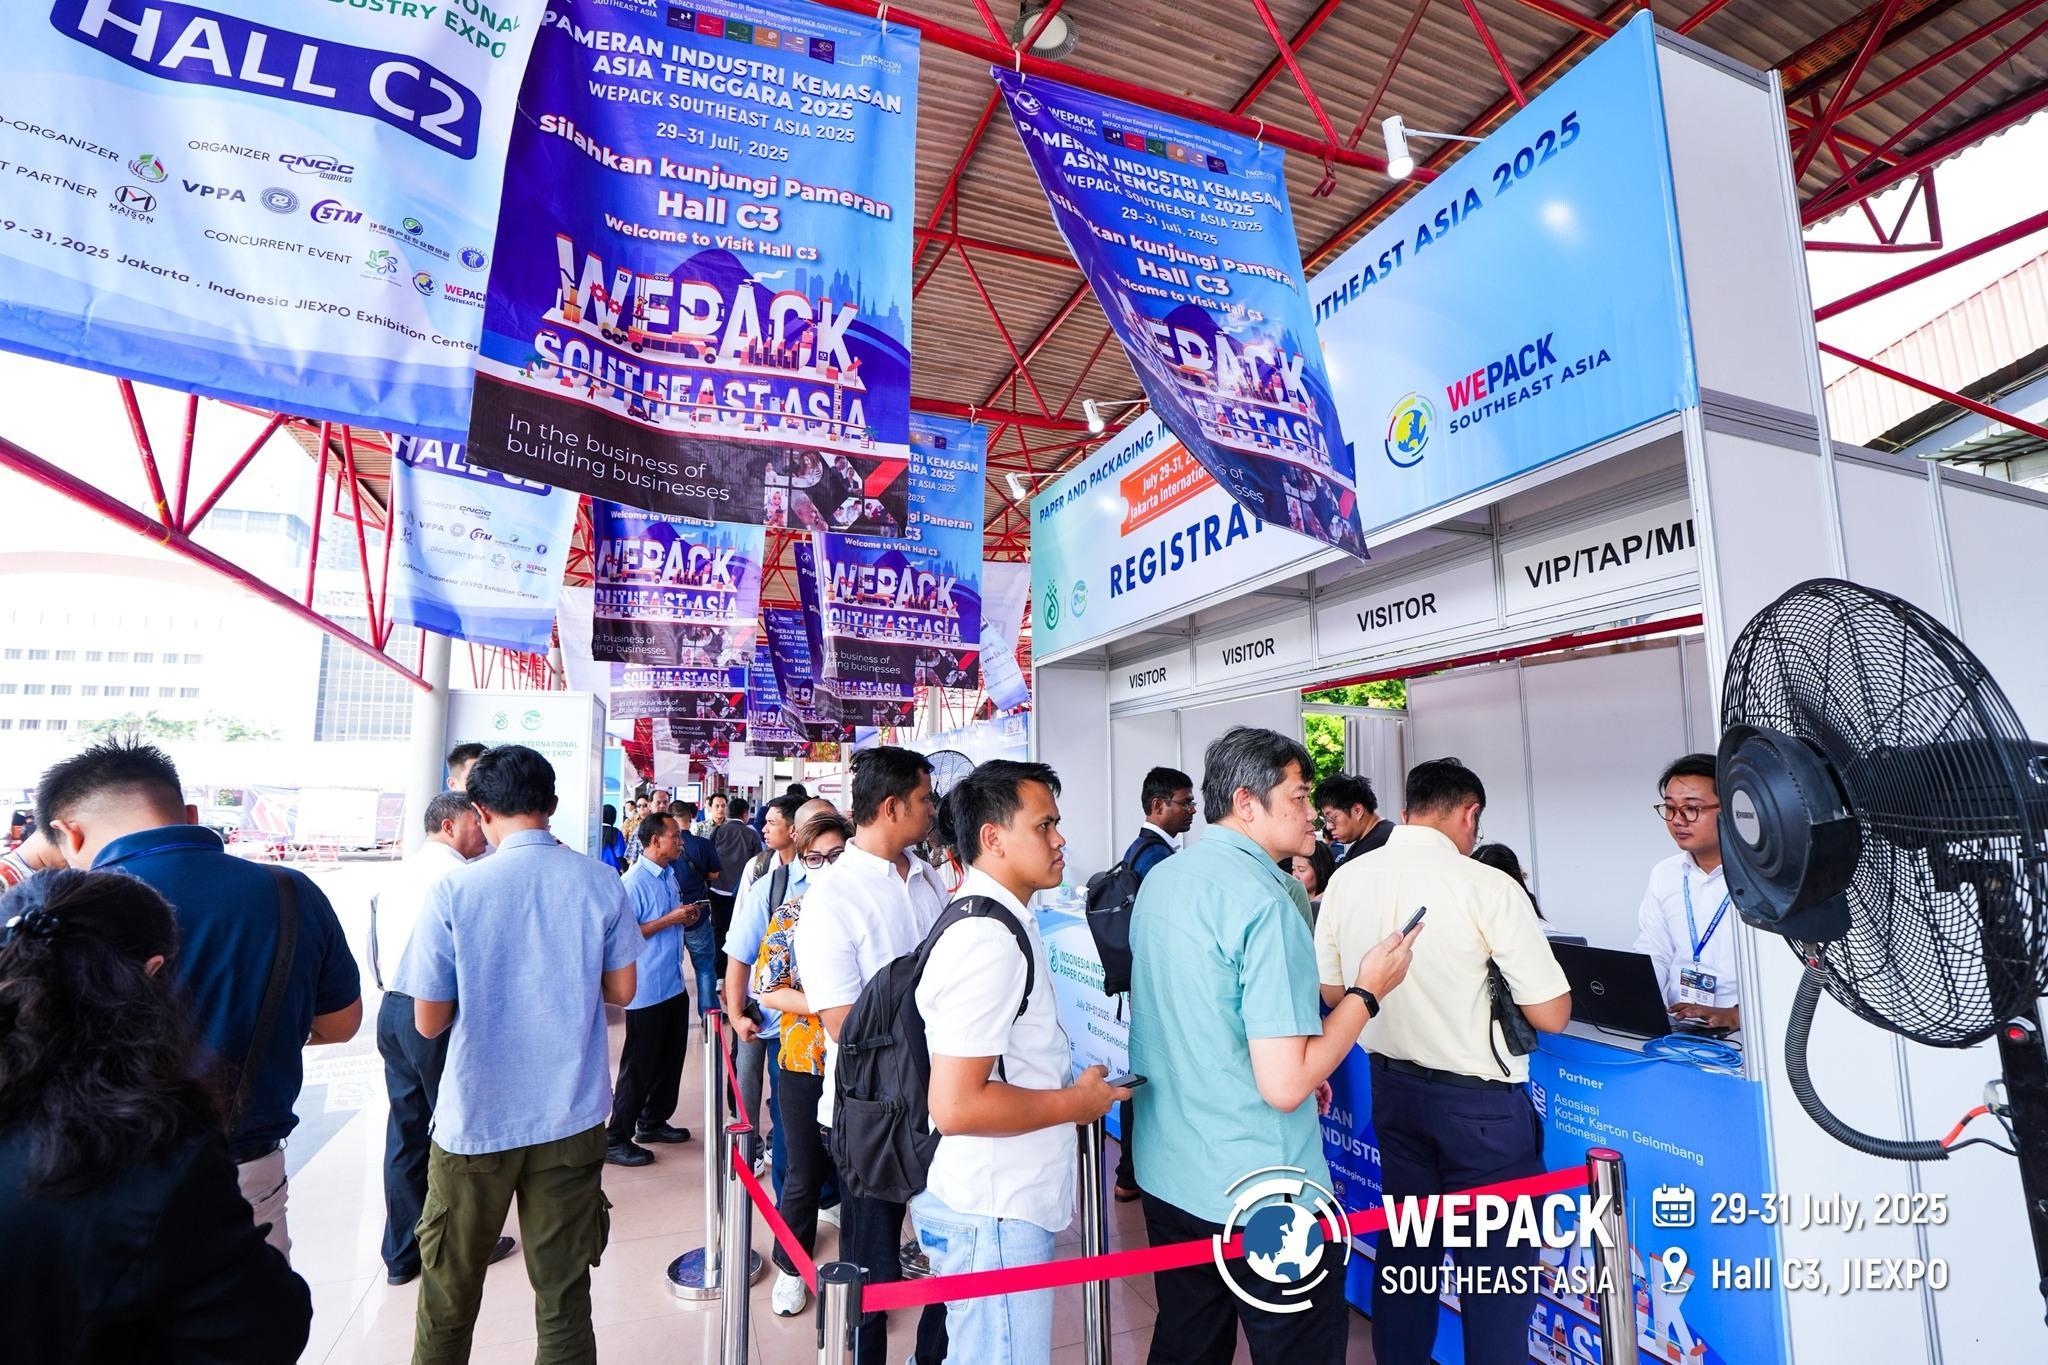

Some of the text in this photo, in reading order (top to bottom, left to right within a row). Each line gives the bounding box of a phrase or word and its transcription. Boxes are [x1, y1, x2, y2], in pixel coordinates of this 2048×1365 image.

[640, 6, 658, 18] ASIA
[695, 4, 729, 17] SOUTHEAST
[444, 10, 507, 58] EXPO
[78, 0, 464, 147] HALL C2
[541, 10, 664, 59] PAMERAN
[672, 45, 785, 86] INDUSTRI
[792, 71, 902, 113] KEMASAN
[862, 54, 901, 70] PACKCON
[592, 55, 854, 120] ASIA TENGGARA 2025
[589, 80, 855, 143] WEPACK SOUTHEAST ASIA 2025
[1048, 106, 1096, 129] WEPACK
[188, 140, 271, 162] ORGANIZER
[709, 134, 744, 156] Juli,
[749, 141, 789, 162] 2025
[539, 113, 892, 220] Silahkan kunjungi Pameran
[1018, 120, 1110, 166] PAMERAN
[1113, 157, 1199, 190] INDUSTRI
[1202, 180, 1284, 214] KEMASAN
[16, 166, 98, 198] PARTNER
[182, 179, 246, 202] VPPA
[1062, 151, 1256, 217] ASIA TENGGARA 2025
[1414, 187, 1484, 257] ASIA
[1492, 110, 1582, 199] 2025
[109, 203, 154, 223] MAISON
[657, 190, 781, 232] Hall C3
[1062, 171, 1264, 232] WEPACK SOUTHEAST ASIA 2025
[204, 229, 352, 264] CONCURRENT EVENT
[604, 213, 818, 260] Welcome to Visit Hall C3
[1161, 220, 1186, 237] Juli,
[1187, 228, 1218, 246] 2025
[1130, 234, 1218, 272] kunjungi
[1136, 257, 1231, 296] Hall C3
[117, 254, 190, 282] Jakarta
[208, 281, 289, 309] Indonesia
[294, 298, 351, 318] JIEXPO
[357, 310, 426, 341] Exhibition
[554, 232, 861, 376] WEPACK
[1115, 271, 1245, 317] elcome to Visit Hall
[533, 329, 868, 437] SOUTHEAST ASIA
[1446, 331, 1557, 412] WEPACK
[1449, 348, 1611, 434] SOUTHEAST ASIA
[508, 413, 707, 478] In the business of
[507, 434, 730, 501] building businesses
[926, 456, 979, 473] KEMASAN
[930, 468, 955, 480] 2025
[1039, 497, 1065, 524] PAPER
[1066, 480, 1087, 505] AND
[1089, 430, 1155, 489] PACKAGING
[1142, 470, 1158, 495] July
[1159, 457, 1185, 478] 29-31,
[1229, 468, 1245, 480] of
[918, 480, 956, 493] ASIA 2025
[610, 510, 682, 524] Welcome to Visit
[923, 512, 973, 530] Pameran
[1130, 492, 1158, 523] Jakarta
[419, 521, 444, 532] VPPA
[844, 537, 938, 557] Welcome to Visit Hall C3
[526, 563, 548, 573] WEPACK
[428, 573, 540, 600] Indonesia Exhibition Center
[823, 560, 958, 614] WEPACK
[692, 592, 737, 619] ASIA
[1356, 592, 1437, 633] VISITOR
[603, 634, 656, 645] business of
[920, 618, 962, 643] ASIA
[616, 645, 666, 655] businesses
[840, 650, 891, 665] business of
[1221, 637, 1275, 666] VISITOR
[851, 662, 901, 675] businesses
[1129, 666, 1167, 690] VISITOR
[1060, 951, 1090, 970] INDONESIA
[1060, 965, 1095, 988] PAPER CHAIN
[1559, 1067, 1604, 1090] Partner
[1554, 1093, 1600, 1117] Asosiasi
[1554, 1106, 1704, 1166] Kotak Karton Gelombang
[1555, 1119, 1607, 1146] Indonesia
[1331, 1160, 1366, 1187] Packaging
